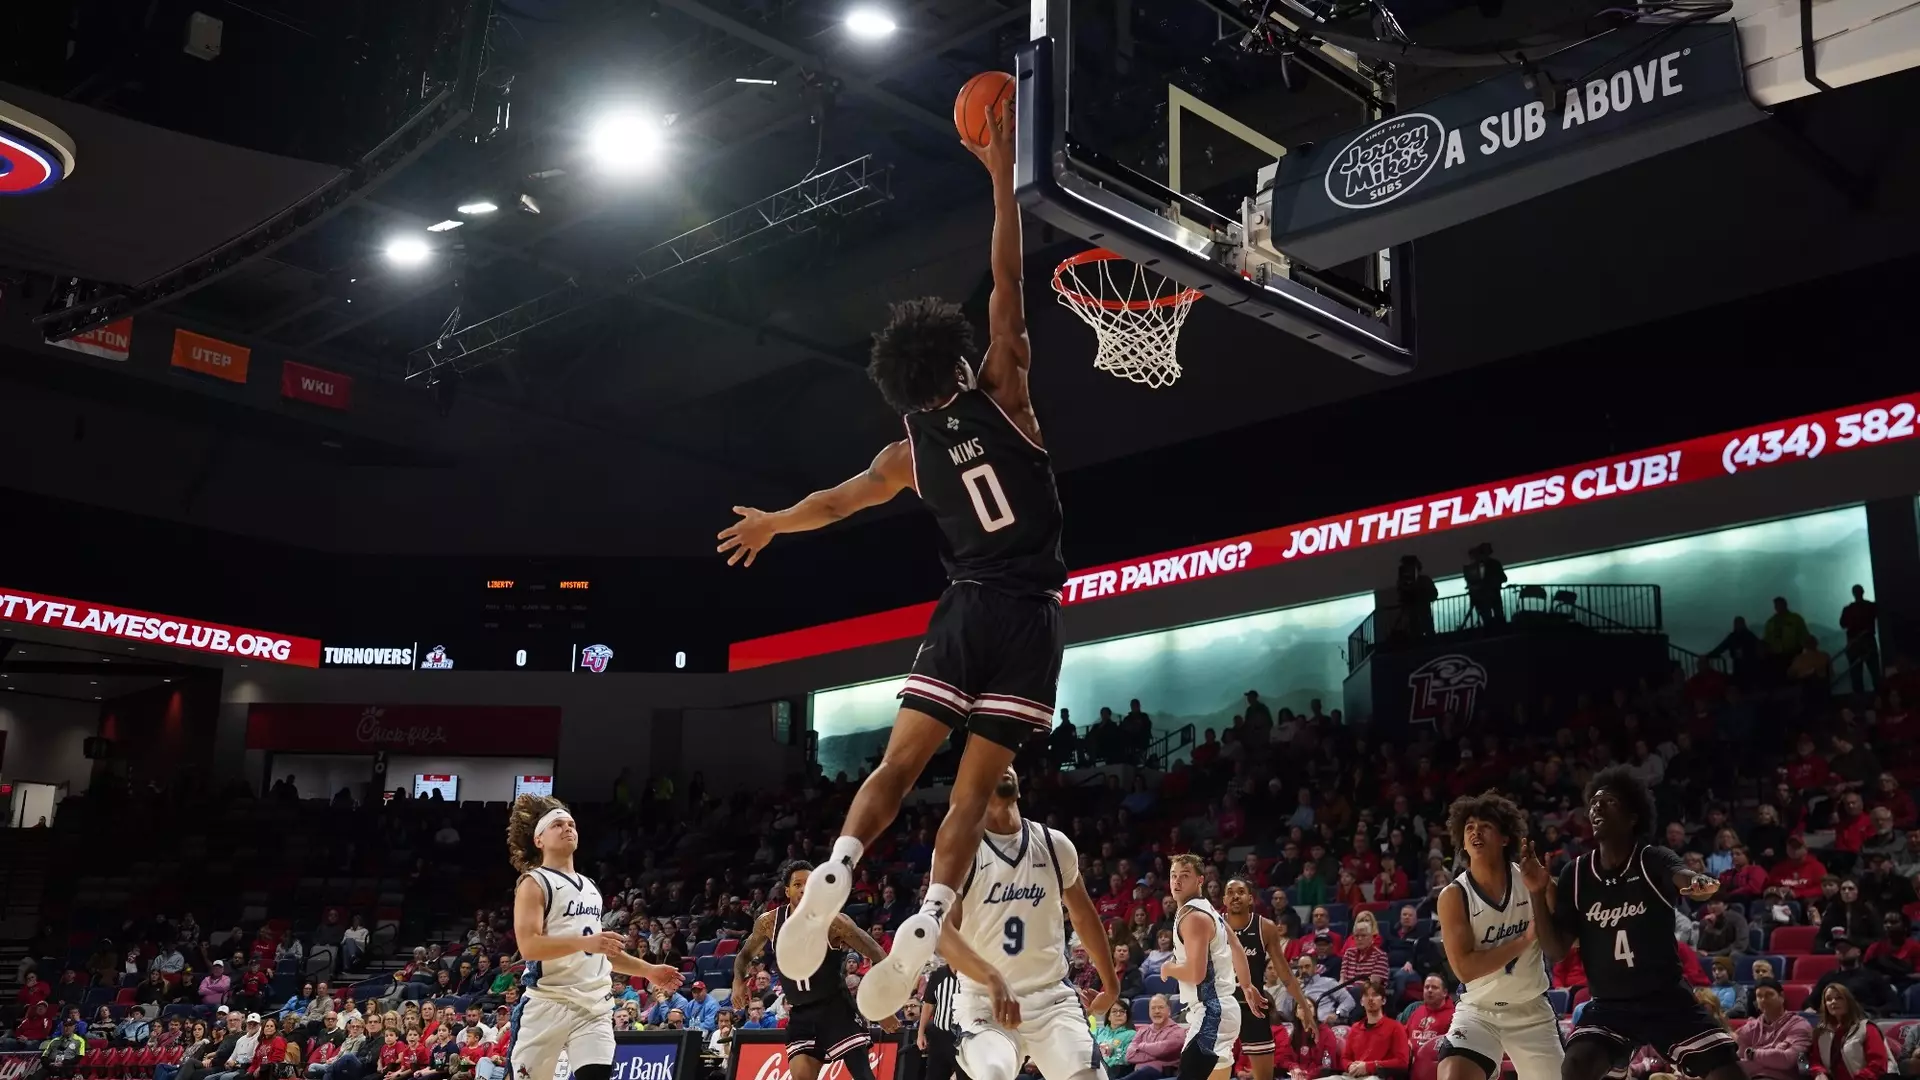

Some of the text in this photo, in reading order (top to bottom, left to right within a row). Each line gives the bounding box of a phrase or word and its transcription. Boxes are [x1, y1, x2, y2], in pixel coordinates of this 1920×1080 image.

[1365, 129, 1385, 142] SINCE
[1445, 129, 1466, 169] A
[1480, 101, 1546, 155] SUB
[1340, 124, 1429, 174] Jersey
[1370, 179, 1403, 200] SUBS
[77, 329, 127, 348] STON
[191, 346, 232, 367] UTEP
[301, 376, 334, 396] WKU
[948, 437, 985, 466] MIMS
[1722, 403, 1920, 475] (434) 582
[961, 463, 1015, 533] 0
[1282, 450, 1682, 558] JOIN THE FLAMES CLUB!
[1120, 541, 1252, 592] PARKING?
[487, 581, 514, 589] LIBERTY
[560, 581, 589, 589] NMSTATE
[324, 646, 412, 665] TURNOVERS
[516, 649, 527, 667] 0
[675, 651, 686, 668] 0
[983, 882, 1046, 907] Liberty
[563, 900, 600, 922] Liberty
[1585, 901, 1647, 928] Aggies
[1002, 915, 1024, 957] 9
[1614, 929, 1635, 968] 4
[629, 1054, 674, 1080] Bank
